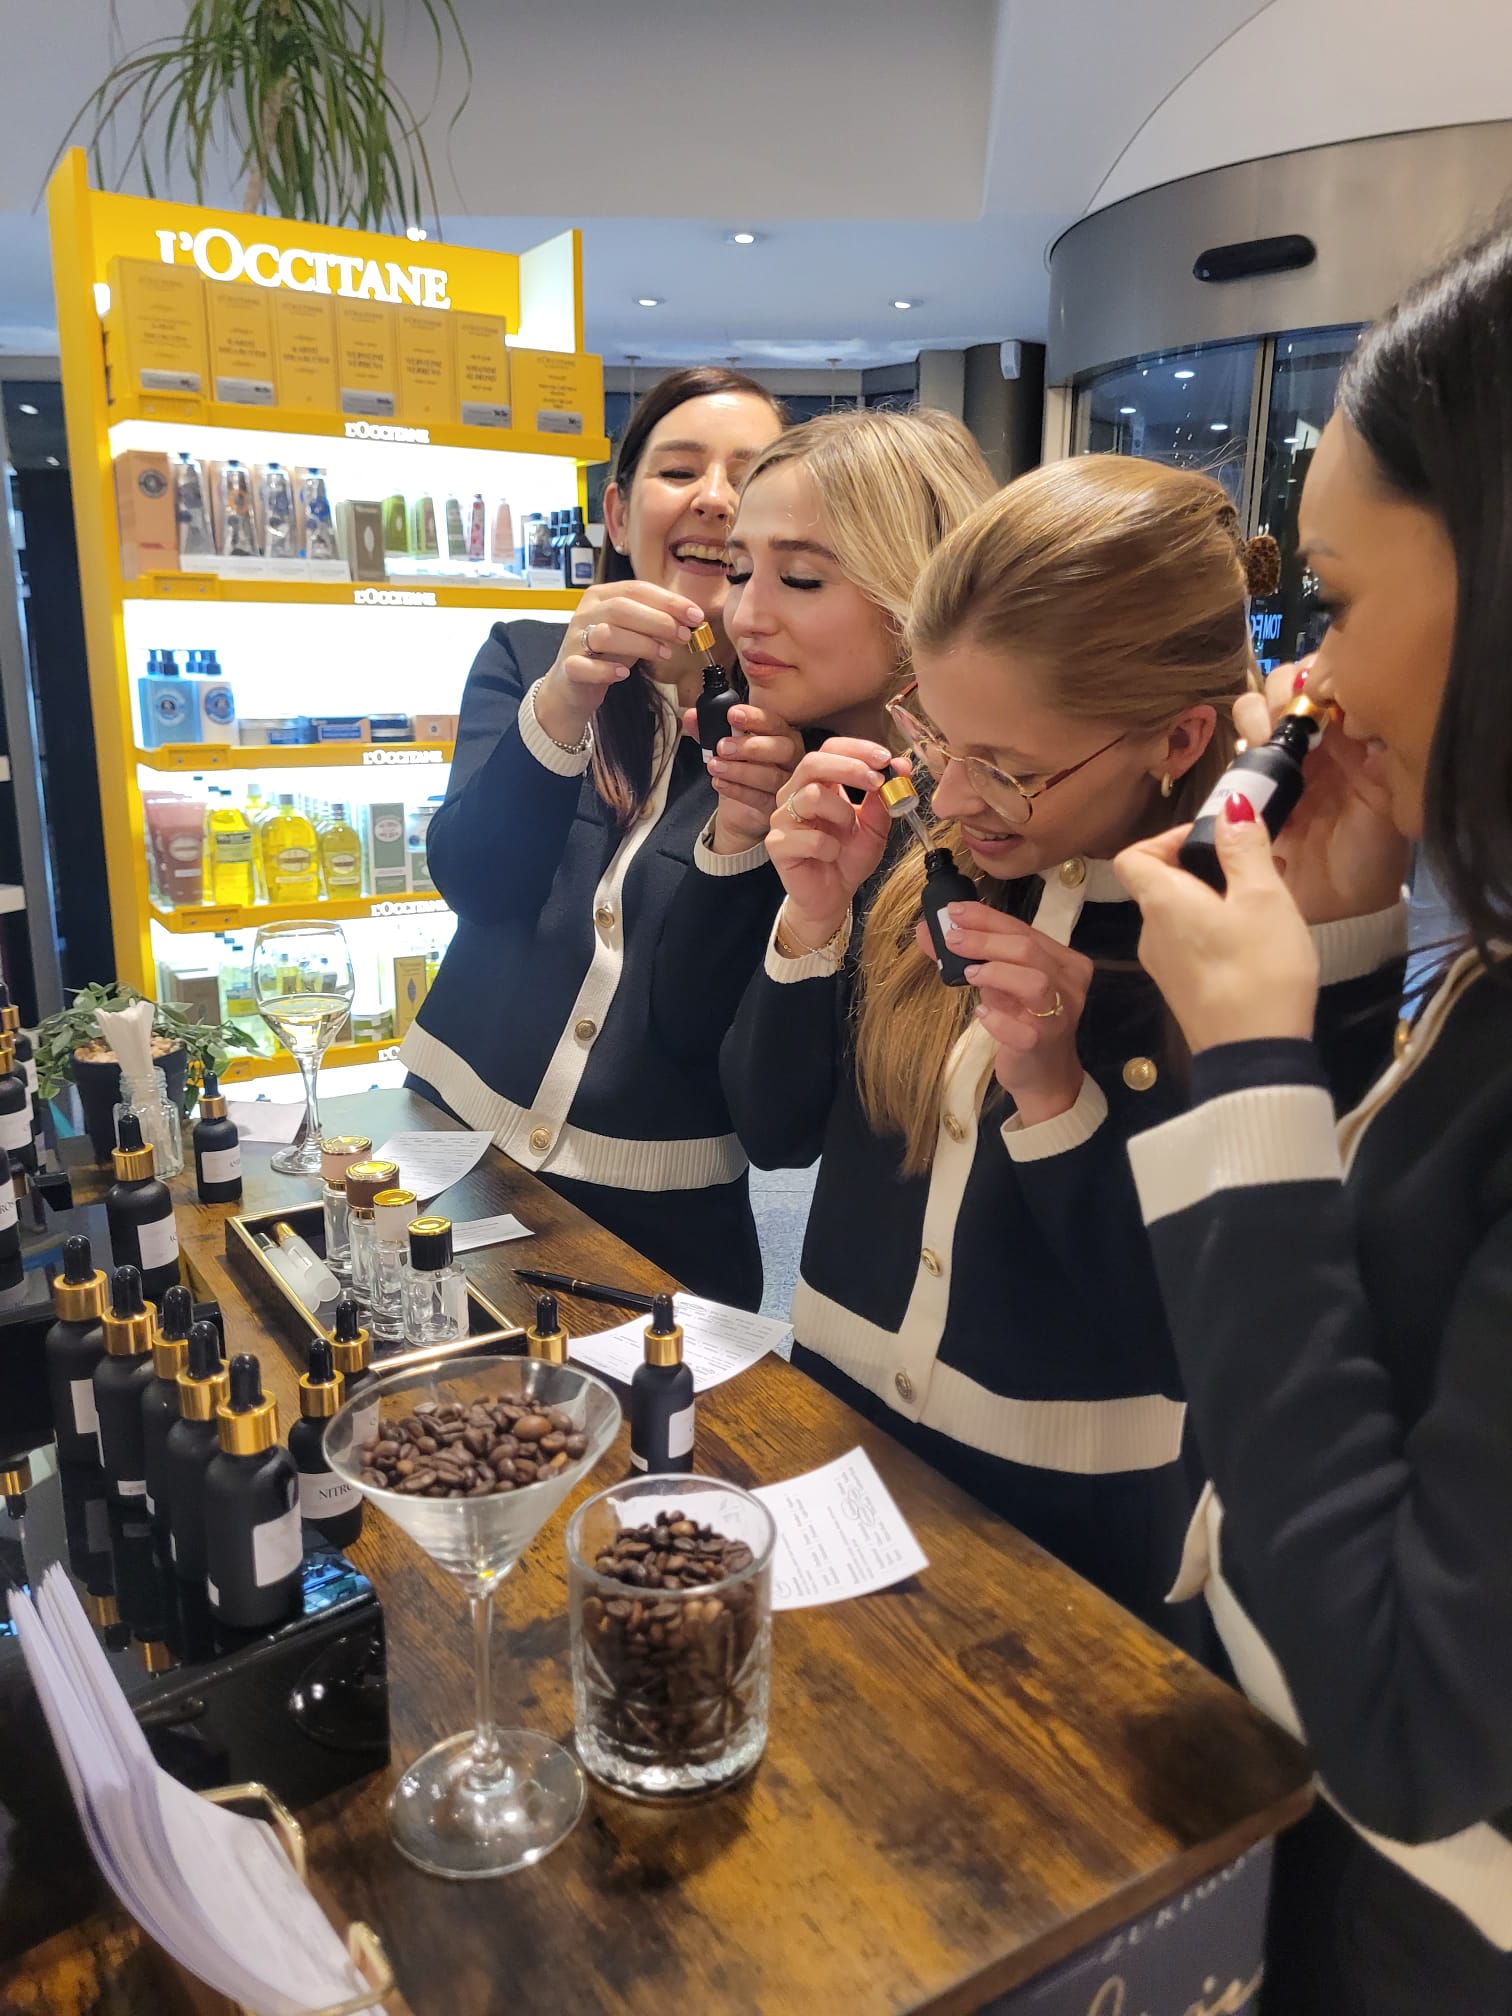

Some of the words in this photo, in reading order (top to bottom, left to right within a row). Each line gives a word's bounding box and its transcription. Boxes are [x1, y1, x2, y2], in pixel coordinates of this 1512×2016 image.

[154, 227, 451, 310] L'OCCITANE
[344, 421, 430, 444] L'OCCITANE
[353, 588, 437, 606] L'OCCITANE
[362, 750, 443, 766] L'OCCITANE
